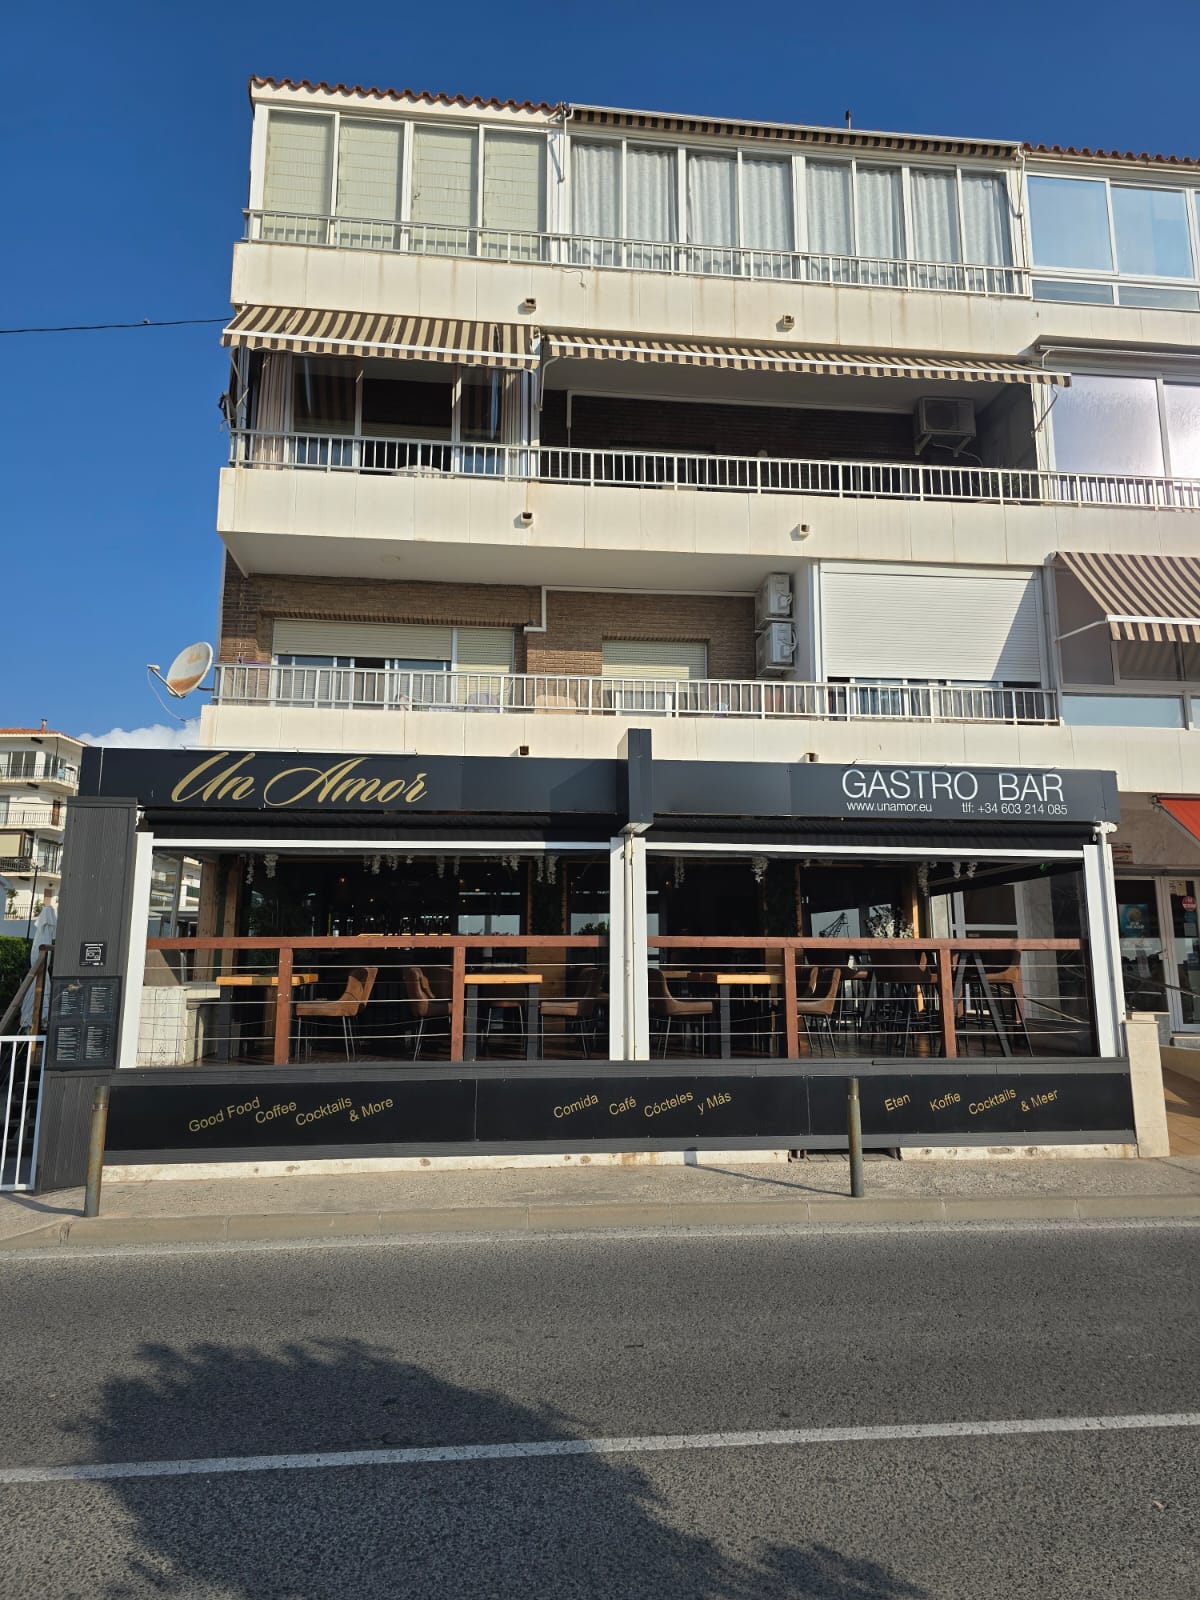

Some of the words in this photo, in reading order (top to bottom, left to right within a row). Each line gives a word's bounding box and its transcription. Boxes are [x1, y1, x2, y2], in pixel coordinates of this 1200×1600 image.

[171, 751, 256, 803] Un
[263, 756, 428, 807] Amor
[841, 769, 979, 801] GASTRO
[999, 772, 1065, 802] BAR
[846, 801, 933, 814] www.unamor.eu
[977, 802, 998, 815] +34
[1001, 803, 1022, 815] 603
[1024, 803, 1045, 816] 214
[1047, 804, 1068, 816] 085
[255, 1101, 297, 1124] Coffee
[295, 1096, 353, 1126] Cocktails
[349, 1110, 359, 1122] &
[361, 1097, 394, 1118] More
[553, 1093, 599, 1119] Comida
[608, 1096, 637, 1116] Café
[644, 1090, 694, 1118] Cócteles
[697, 1103, 705, 1116] y
[706, 1091, 732, 1109] Más
[884, 1093, 911, 1112] Eten
[929, 1091, 961, 1112] Koffie
[967, 1087, 1017, 1116] Cocktails
[1020, 1100, 1030, 1112] &
[1031, 1089, 1059, 1108] Meer
[188, 1109, 225, 1132] Good
[226, 1096, 261, 1119] Food
